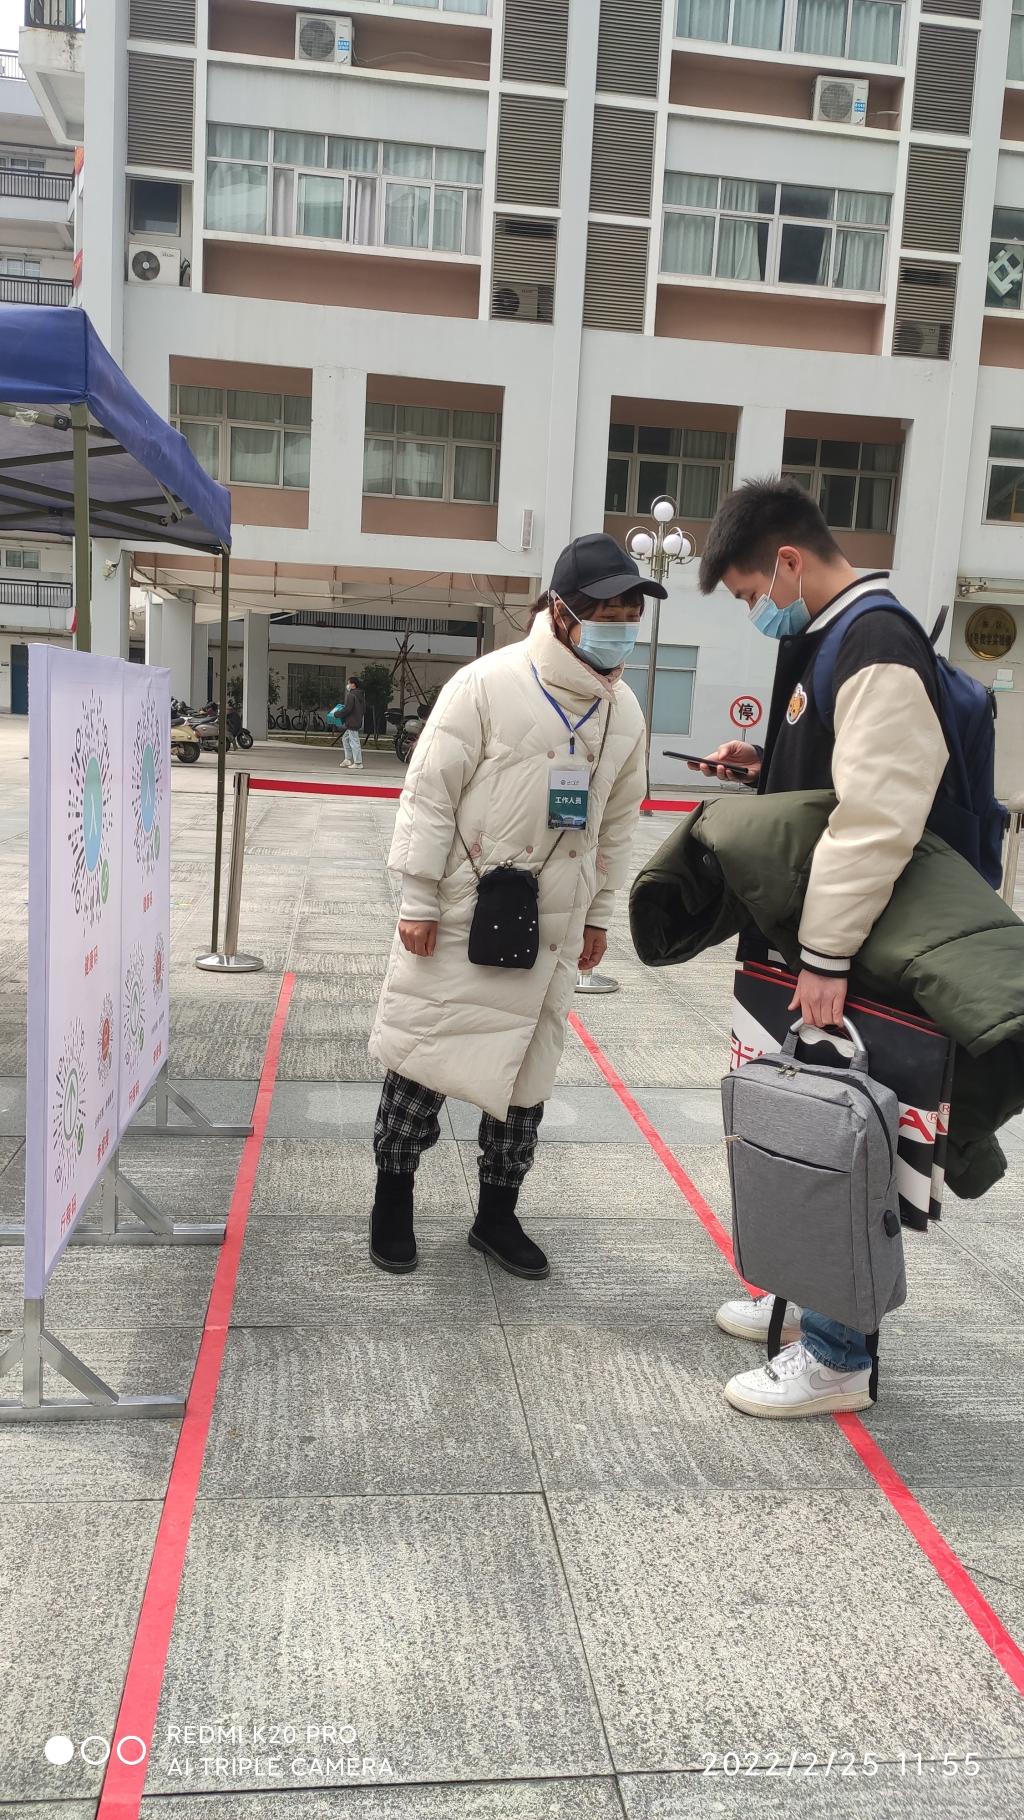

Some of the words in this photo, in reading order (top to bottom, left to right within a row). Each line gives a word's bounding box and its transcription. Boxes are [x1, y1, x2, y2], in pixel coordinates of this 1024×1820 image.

[738, 703, 754, 720] 停
[554, 796, 582, 805] 工作人员
